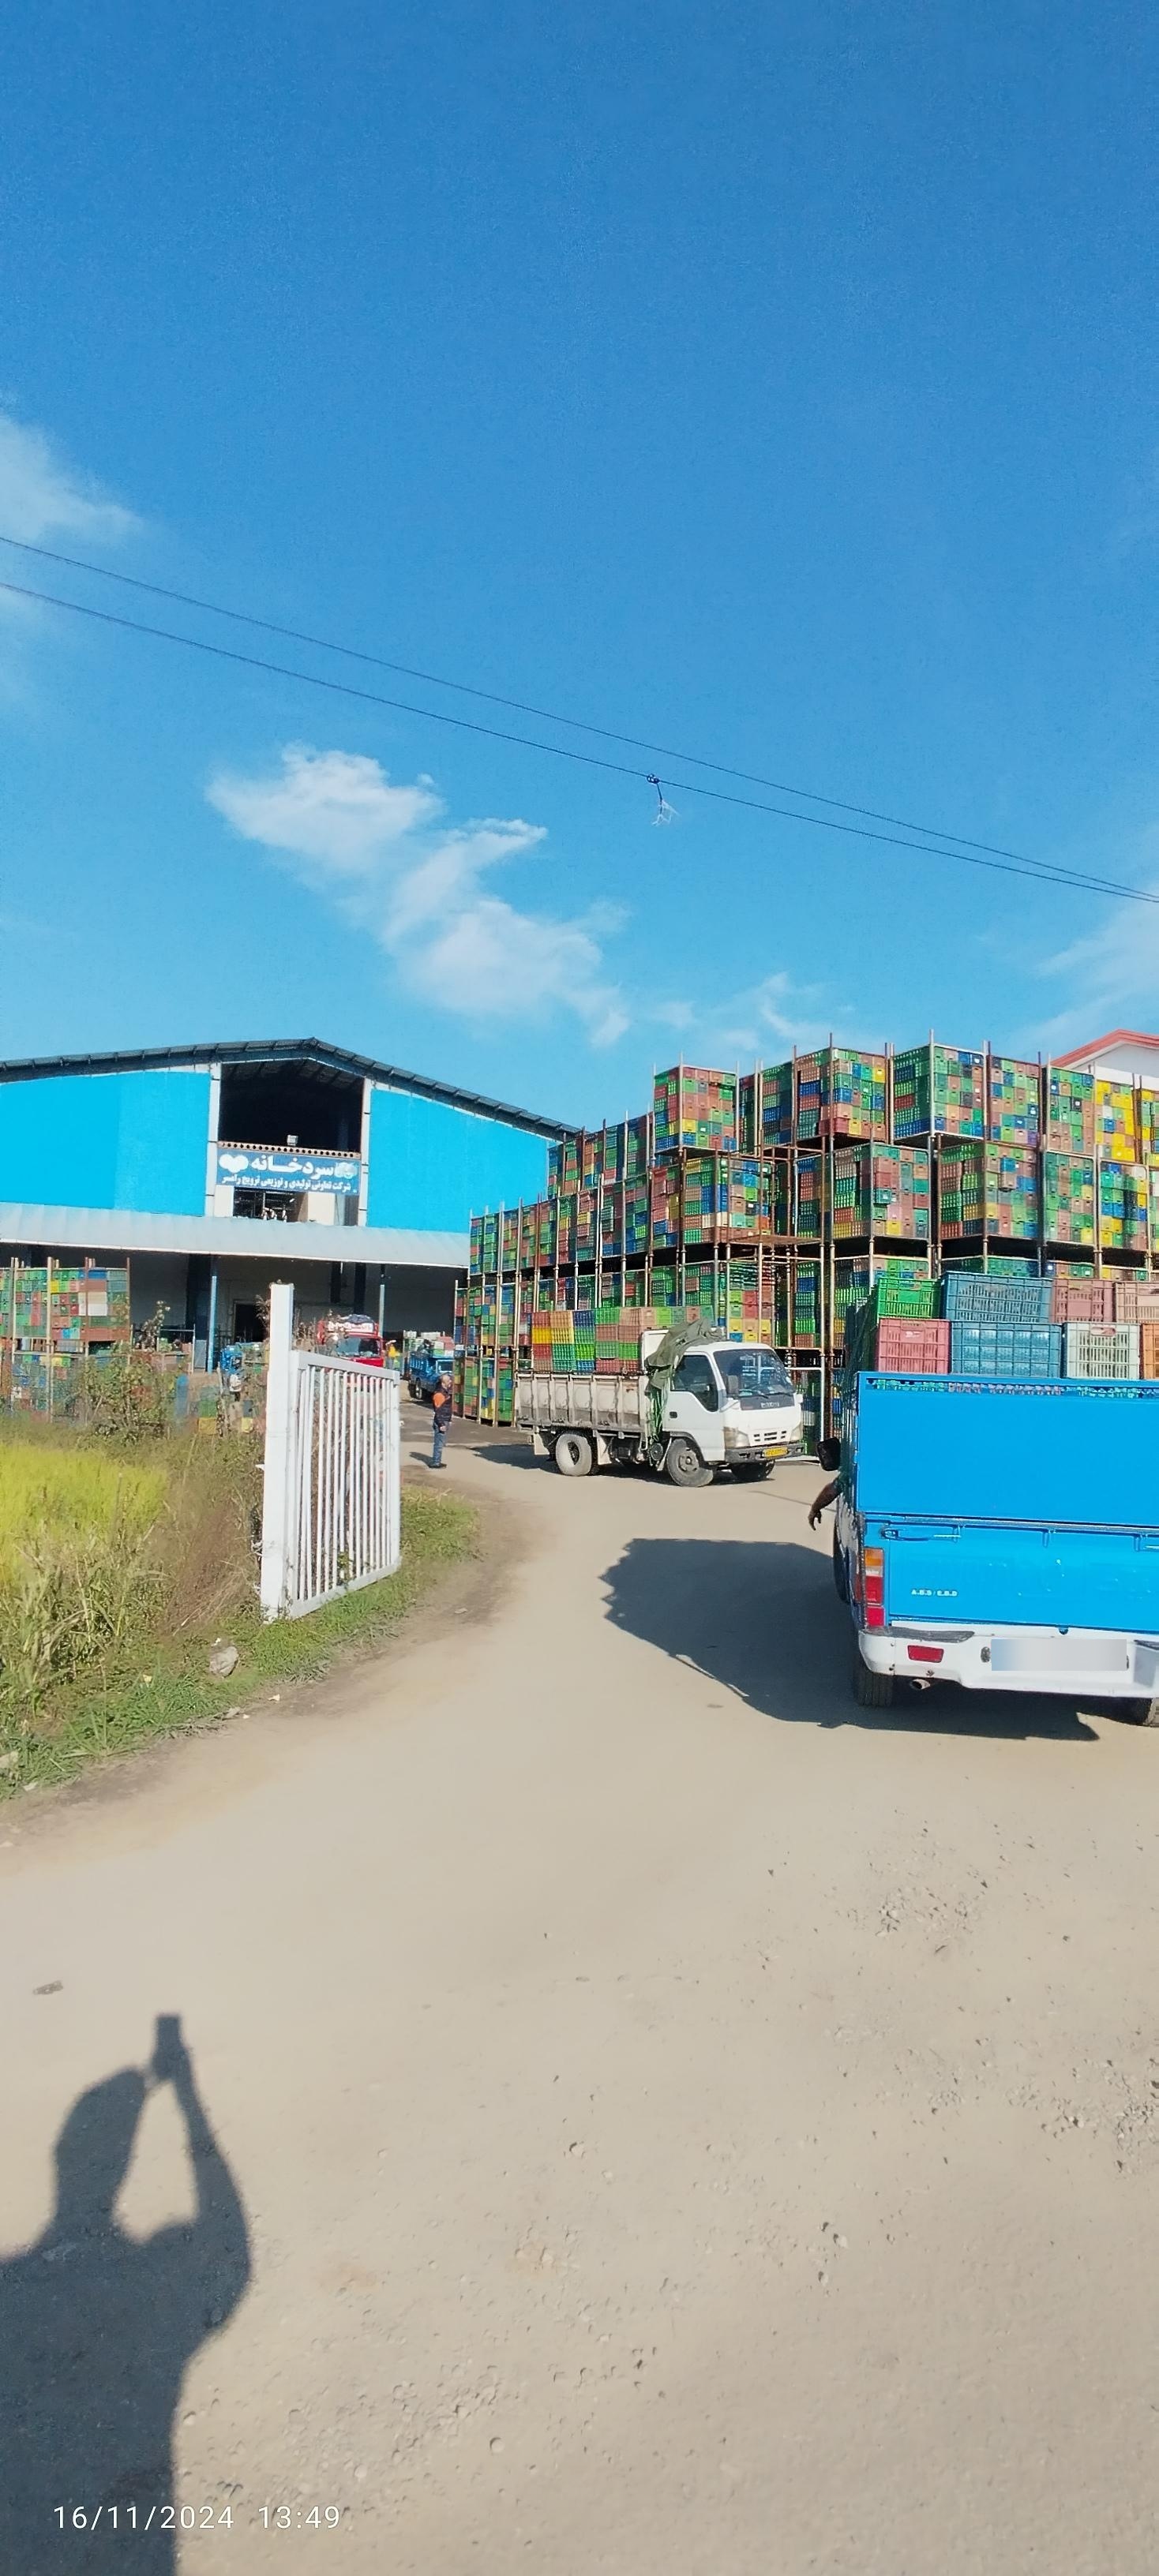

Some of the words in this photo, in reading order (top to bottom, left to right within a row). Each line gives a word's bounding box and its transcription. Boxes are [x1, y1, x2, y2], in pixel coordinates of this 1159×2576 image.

[251, 1155, 334, 1180] سردخانه
[261, 1178, 283, 1188] توزیعی
[289, 1179, 311, 1189] تولیدی
[311, 1181, 332, 1191] تعاونی
[332, 1181, 351, 1193] شرکت
